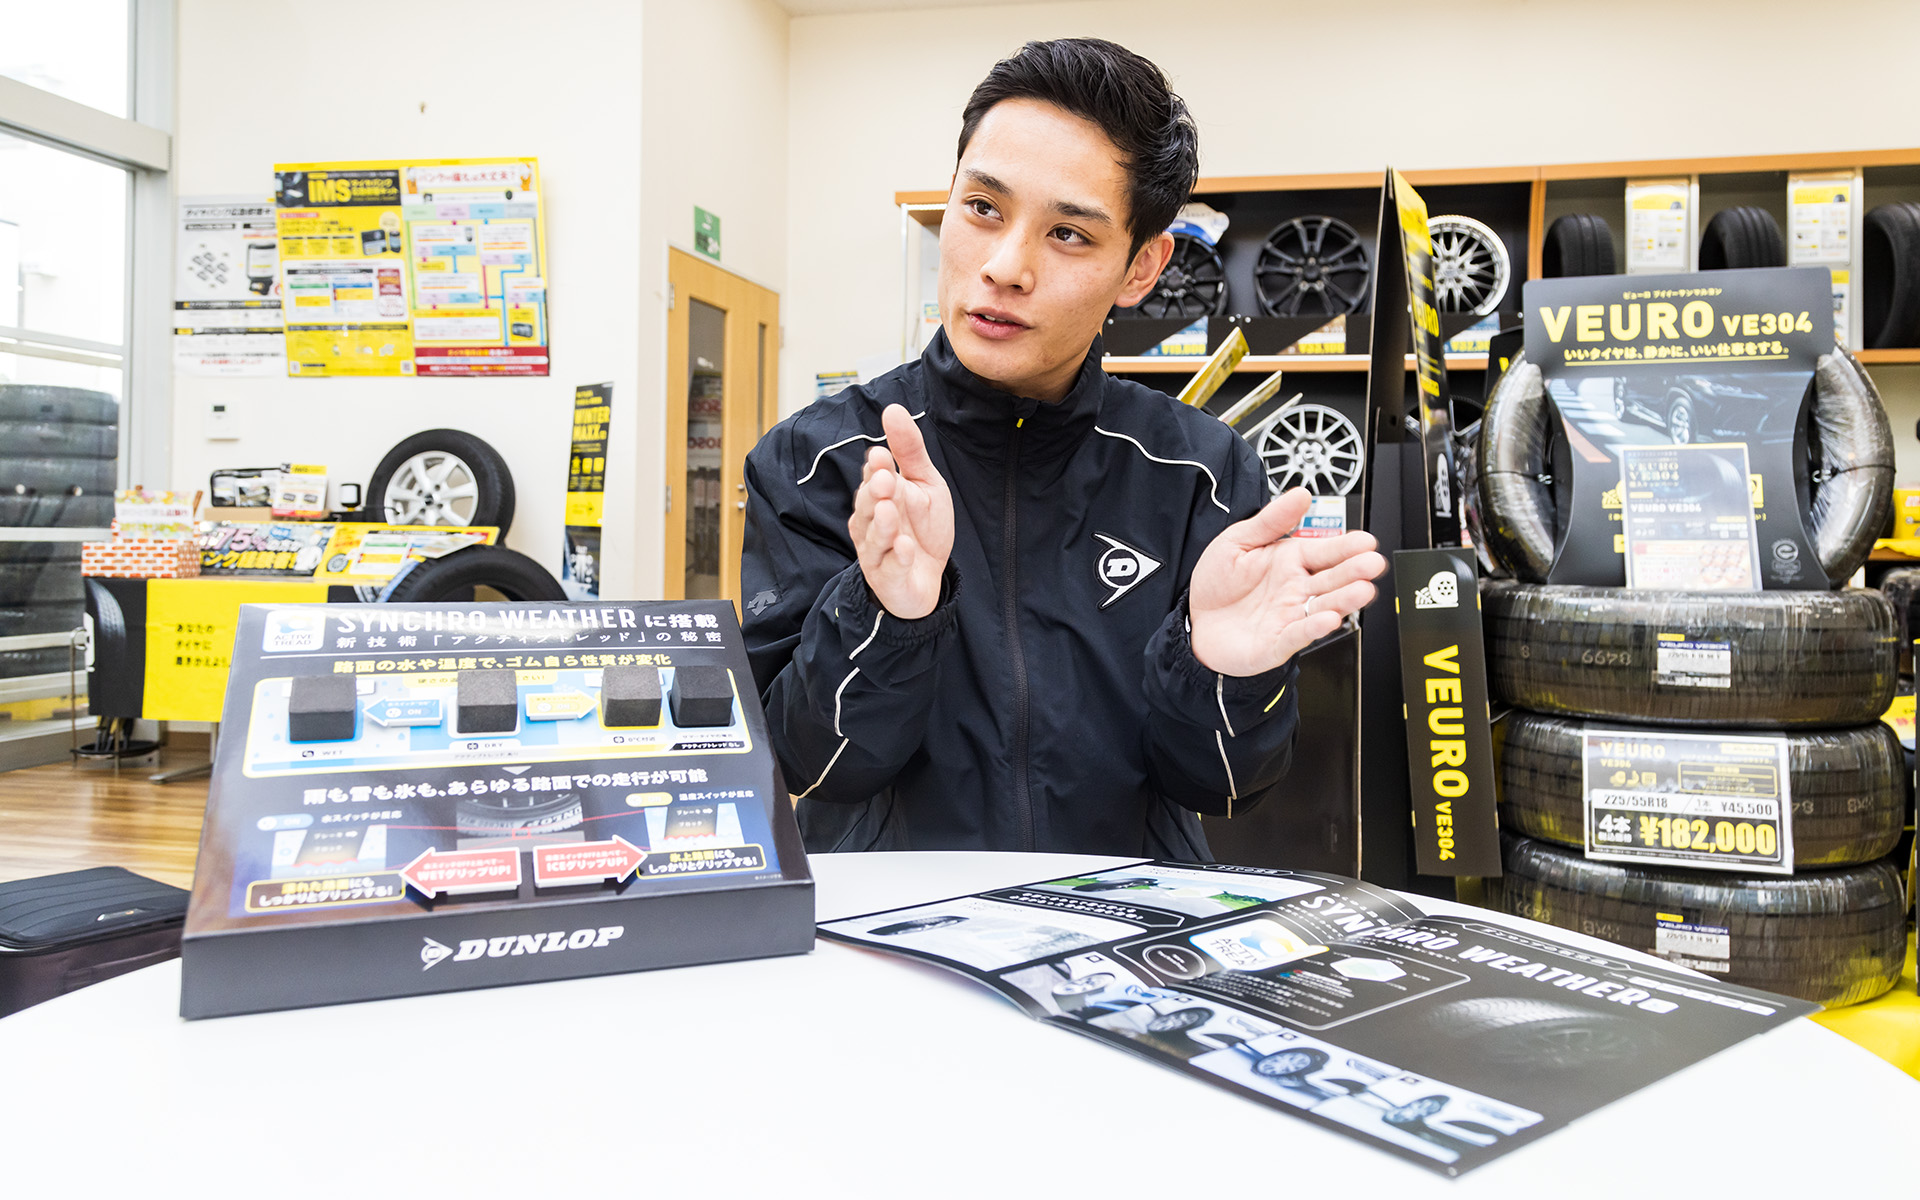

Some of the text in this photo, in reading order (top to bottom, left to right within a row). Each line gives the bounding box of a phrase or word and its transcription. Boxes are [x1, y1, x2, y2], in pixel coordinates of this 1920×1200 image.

[1540, 301, 1813, 342] VEURO VE304
[1564, 341, 1789, 361] いいタイヤは、静かに、いい仕事をする。
[336, 608, 719, 633] SYNCHRO WEATHER に搭載
[333, 653, 672, 674] 路面の水や温度で、ゴム自ら性質が変化
[1423, 644, 1470, 861] VEURO VE304
[1600, 742, 1666, 759] VEURO
[304, 769, 708, 805] 雨も雪も氷も、あらゆる路面での走行が可能
[1604, 794, 1668, 808] 225/55R18
[1721, 801, 1772, 816] ¥45,500
[1598, 814, 1777, 855] 4本 ¥182,000
[416, 865, 511, 881] WETグリップUP!
[546, 856, 628, 872] ICEグリップUP!
[453, 926, 624, 961] DUNLOP
[1210, 938, 1247, 966] TREA
[1221, 937, 1267, 965] ACTIV
[1300, 895, 1460, 950] SYNCHRO
[1458, 945, 1650, 1006] WEATHER
